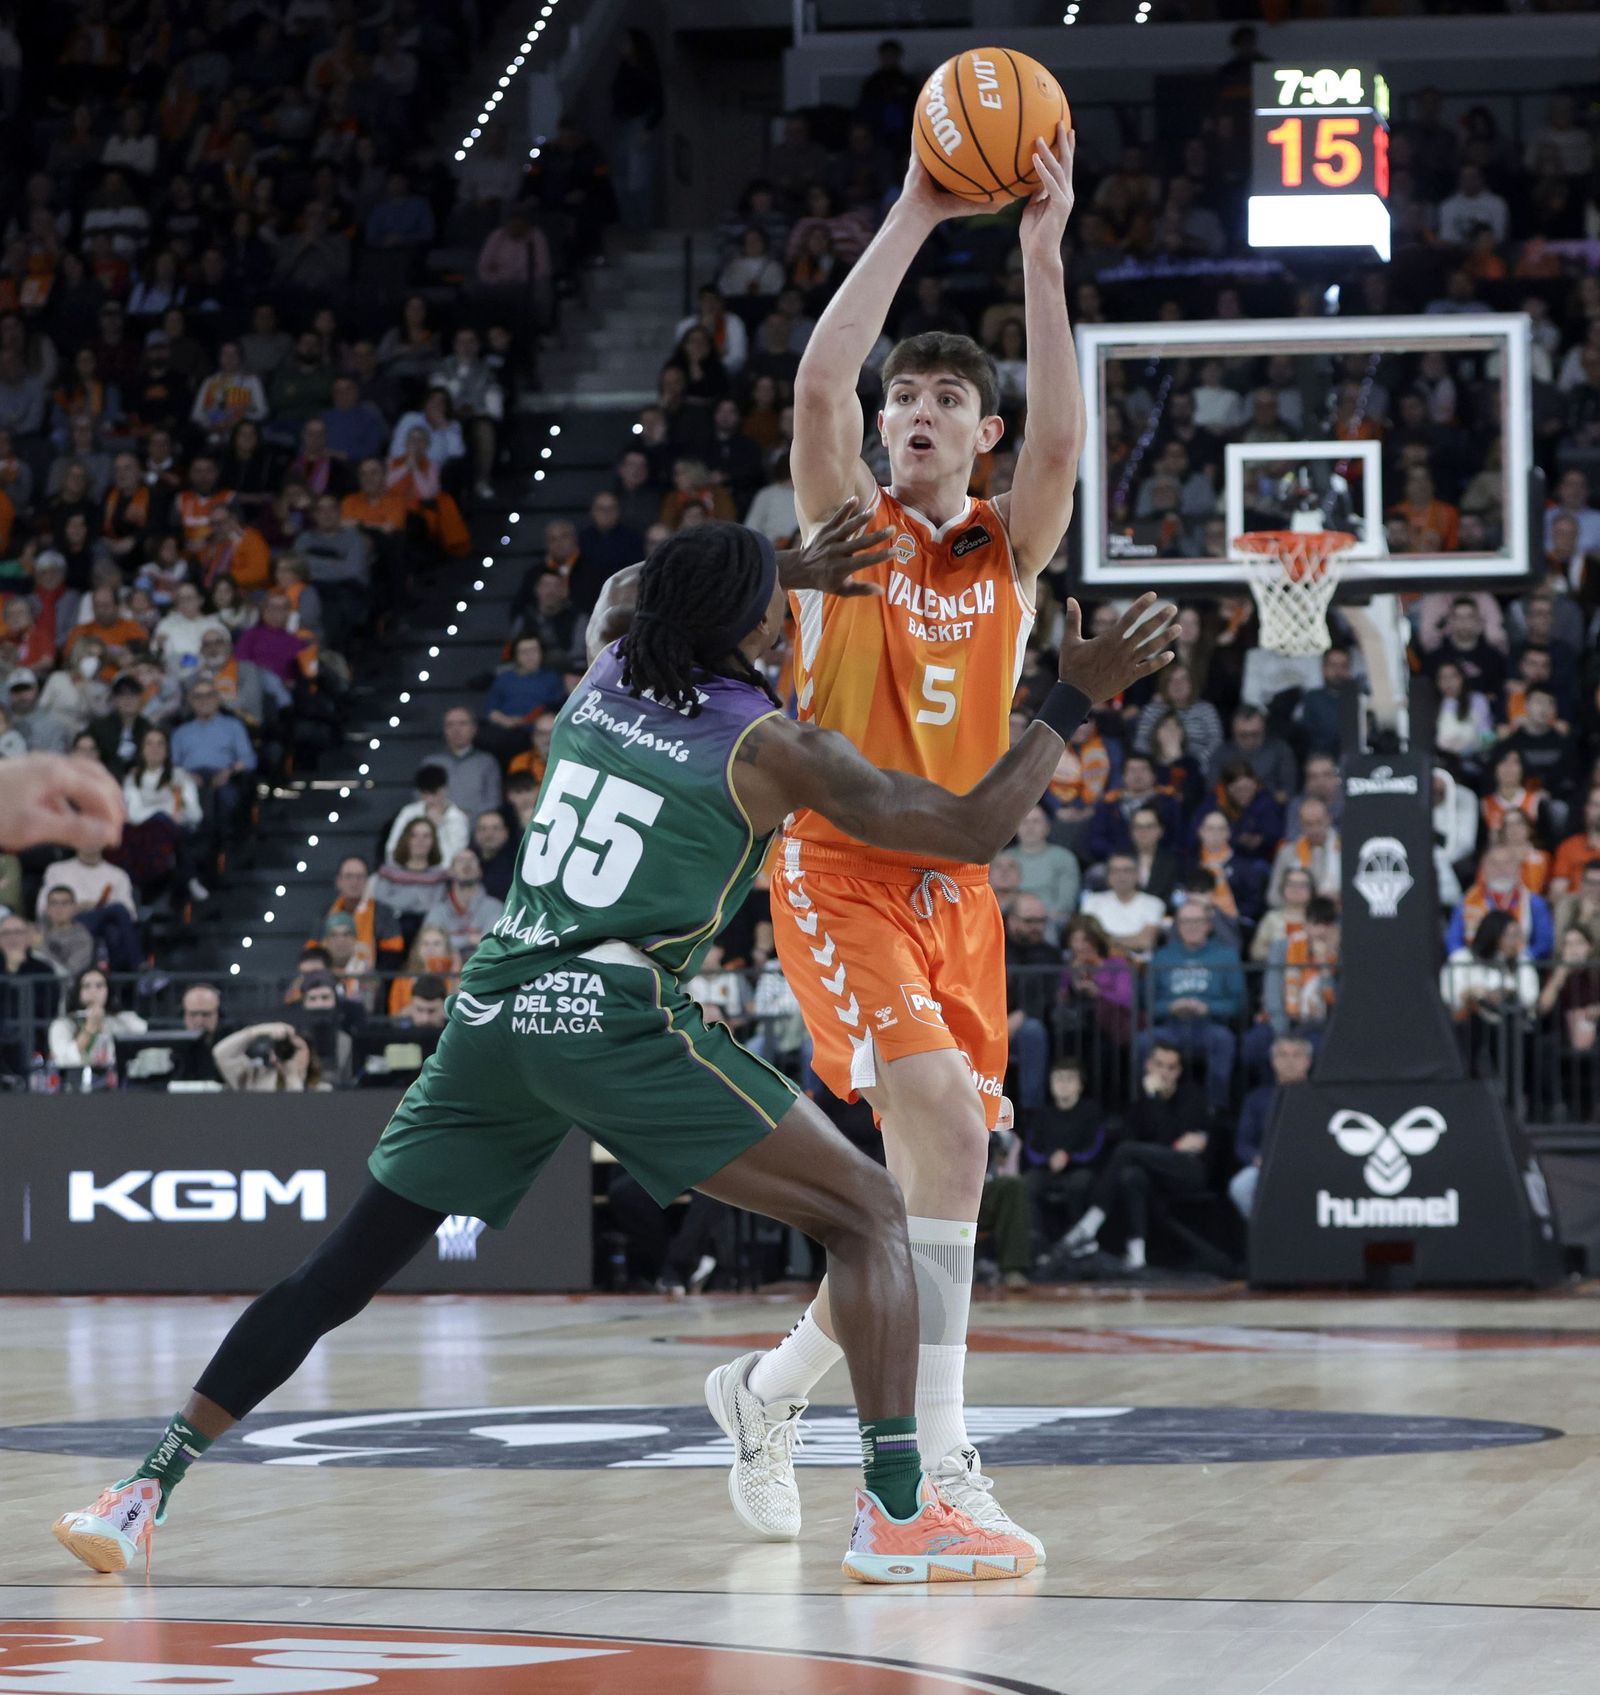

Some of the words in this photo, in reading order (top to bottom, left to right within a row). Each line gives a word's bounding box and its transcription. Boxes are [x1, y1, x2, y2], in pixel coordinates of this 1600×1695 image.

[1274, 68, 1365, 106] 7:04
[1267, 117, 1363, 188] 15
[887, 570, 995, 621] VALENCIA
[908, 616, 974, 642] BASKET
[915, 664, 956, 726] 5
[521, 758, 665, 908] 55
[511, 1013, 604, 1035] MÁLAGA
[513, 994, 552, 1013] DEL
[556, 996, 604, 1016] SOL
[69, 1169, 326, 1222] KGM
[1316, 1188, 1459, 1228] hummel
